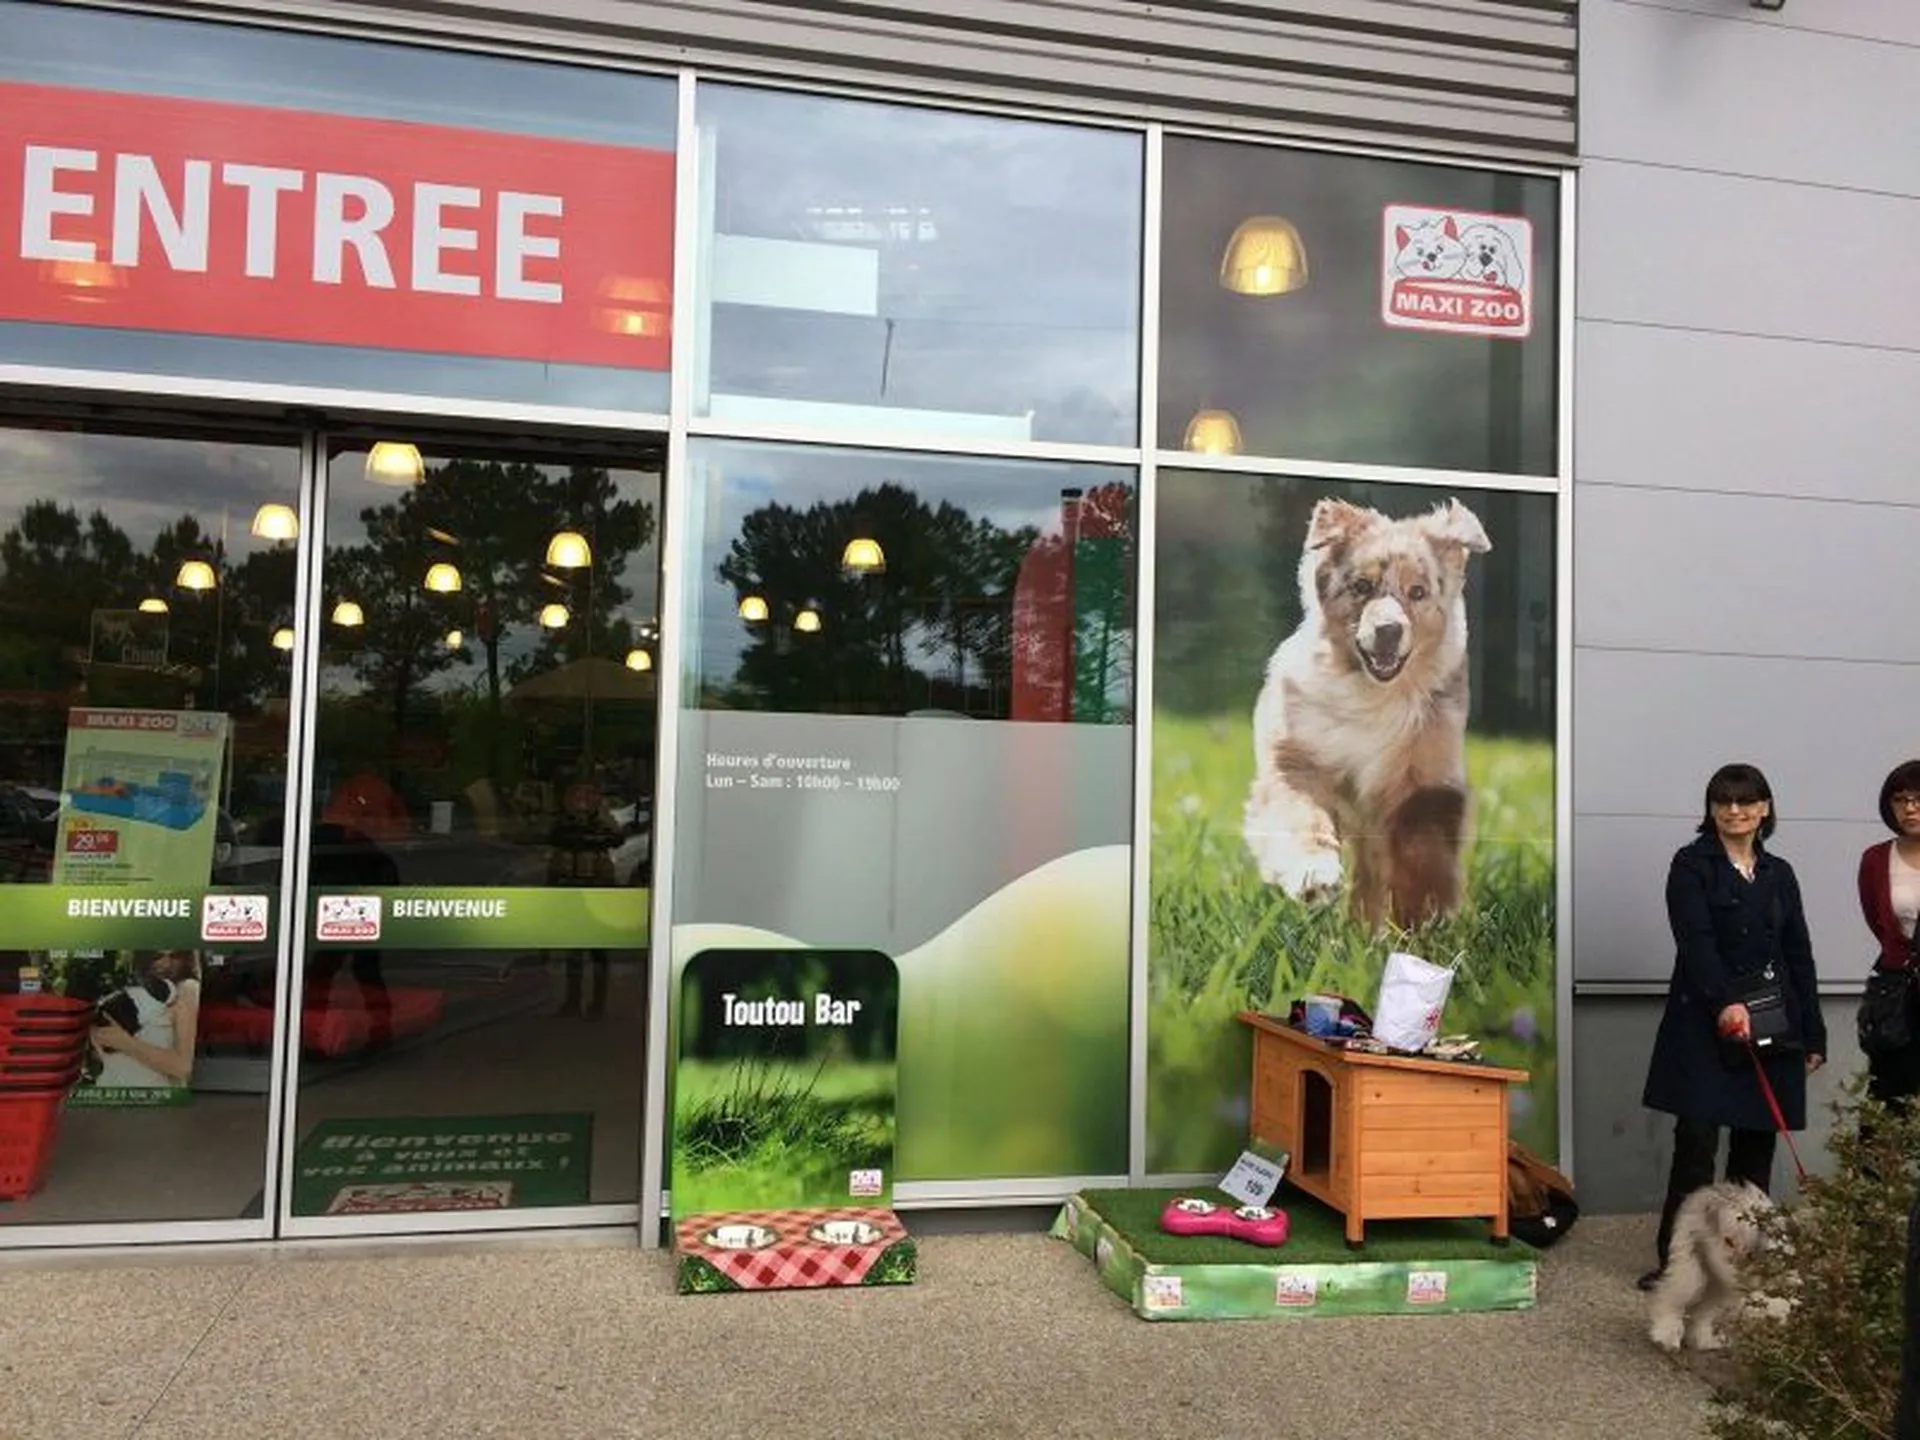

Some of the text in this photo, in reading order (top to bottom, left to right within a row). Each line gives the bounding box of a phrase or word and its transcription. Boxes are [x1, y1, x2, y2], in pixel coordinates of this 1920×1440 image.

[20, 144, 563, 303] ENTREE
[1396, 292, 1520, 320] MAXI ZOO
[138, 715, 175, 729] ZOO
[706, 753, 759, 768] Heures
[706, 775, 733, 788] Lun
[750, 775, 782, 789] Sam
[68, 899, 190, 918] BIENVENUE
[392, 898, 507, 918] BIENVENUE
[722, 993, 862, 1026] Toutou Bar
[320, 1132, 573, 1149] Bienvenue
[379, 1159, 547, 1175] animaux
